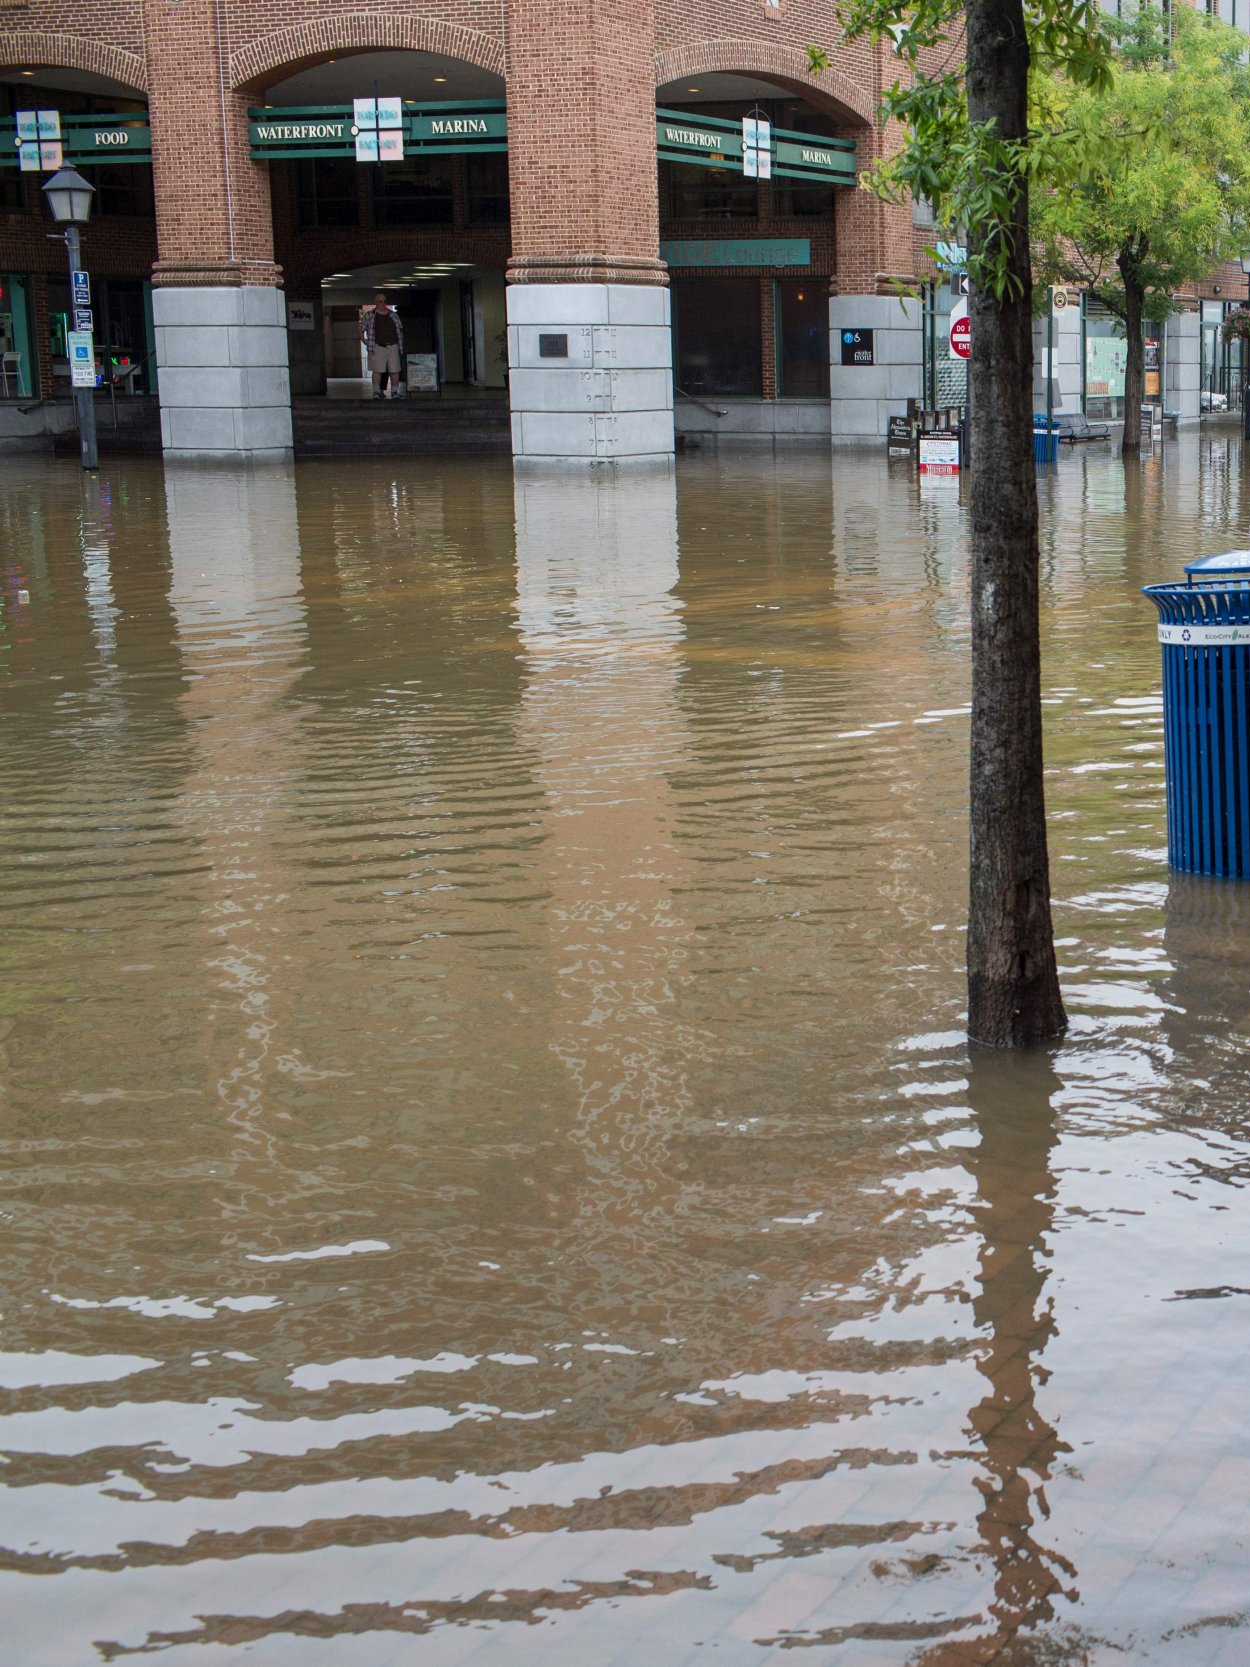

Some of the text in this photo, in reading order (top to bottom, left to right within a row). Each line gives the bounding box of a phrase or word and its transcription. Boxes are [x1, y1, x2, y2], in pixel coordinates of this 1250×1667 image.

[256, 124, 344, 139] WATERFRONT
[431, 119, 488, 134] MARINA
[95, 132, 128, 145] FOOD
[666, 128, 722, 149] WATERFRONT
[802, 150, 832, 165] MARINA
[581, 328, 591, 337] 12
[958, 342, 970, 350] ENT
[583, 350, 591, 359] 11
[580, 372, 592, 381] 10
